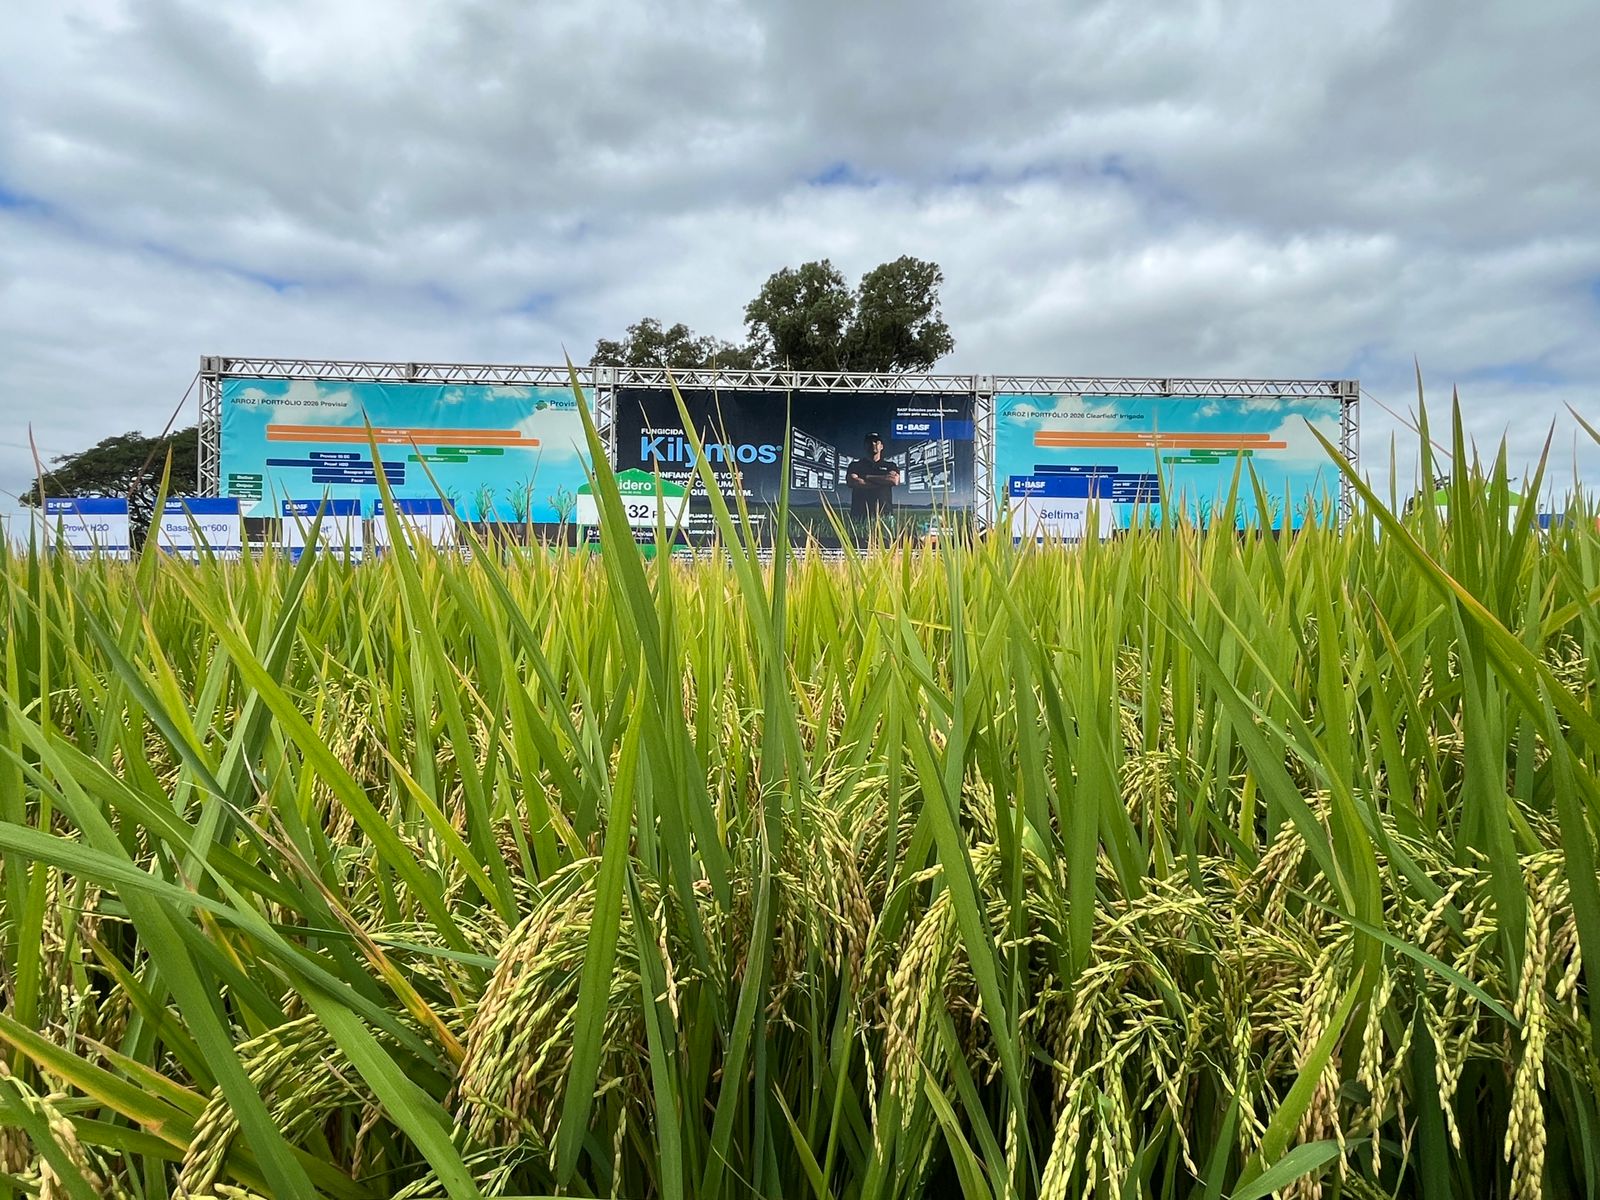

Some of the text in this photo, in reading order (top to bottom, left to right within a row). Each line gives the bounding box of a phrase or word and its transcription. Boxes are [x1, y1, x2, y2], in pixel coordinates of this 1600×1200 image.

[261, 398, 302, 406] PORTFÓLIO
[641, 428, 684, 436] FUNGICIDA
[618, 479, 652, 491] idero
[90, 523, 110, 532] H2O
